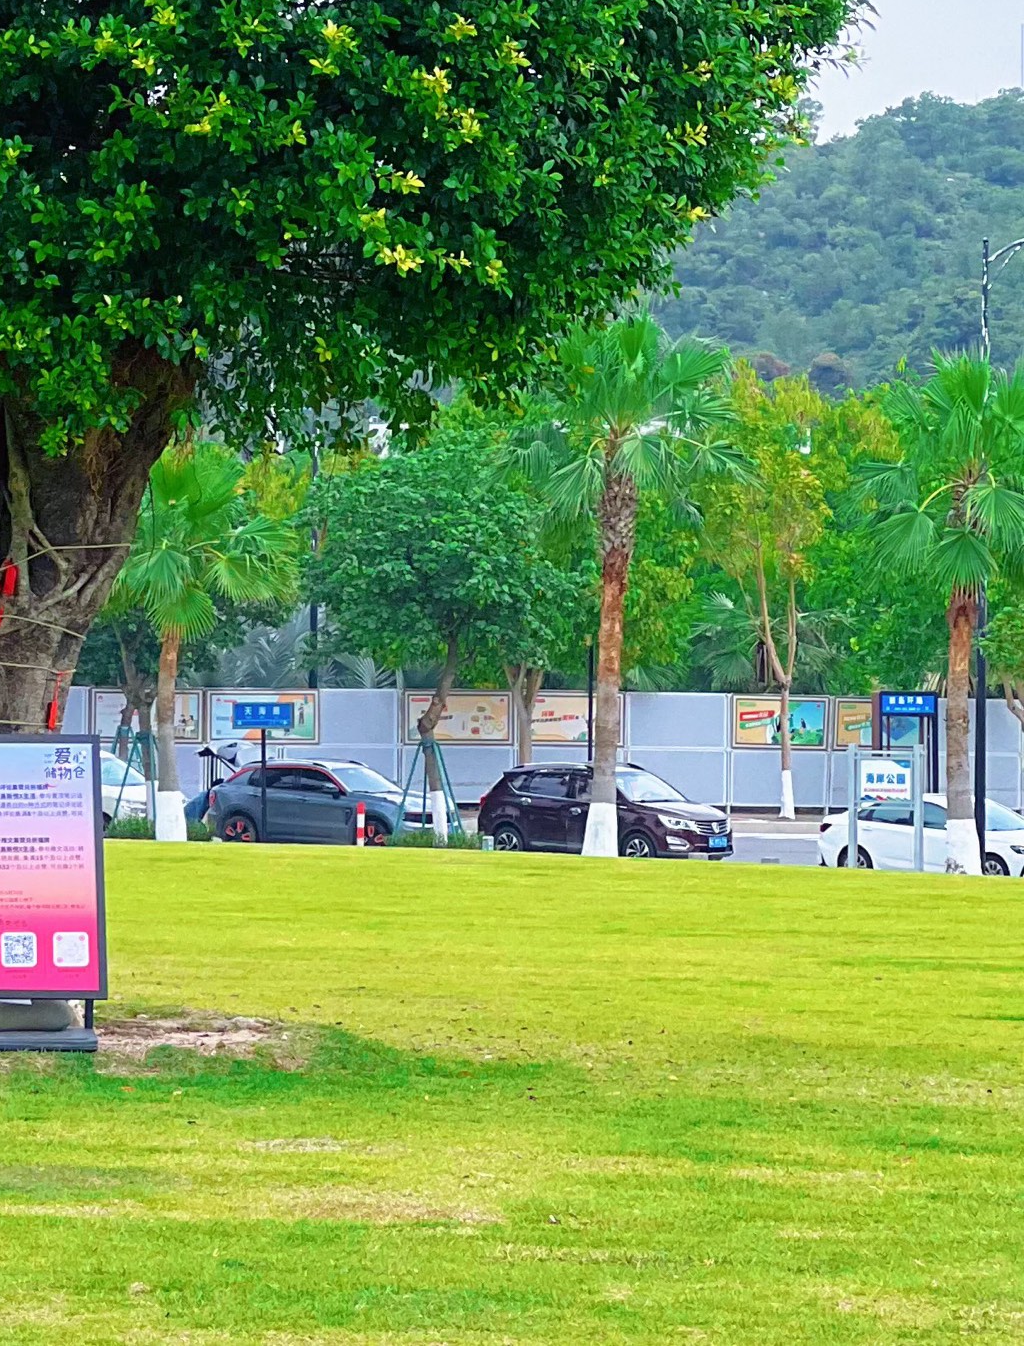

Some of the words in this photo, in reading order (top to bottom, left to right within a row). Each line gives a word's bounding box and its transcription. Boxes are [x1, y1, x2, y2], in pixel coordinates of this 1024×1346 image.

[44, 765, 86, 780] 储物仓
[865, 773, 906, 785] 海岸公园
